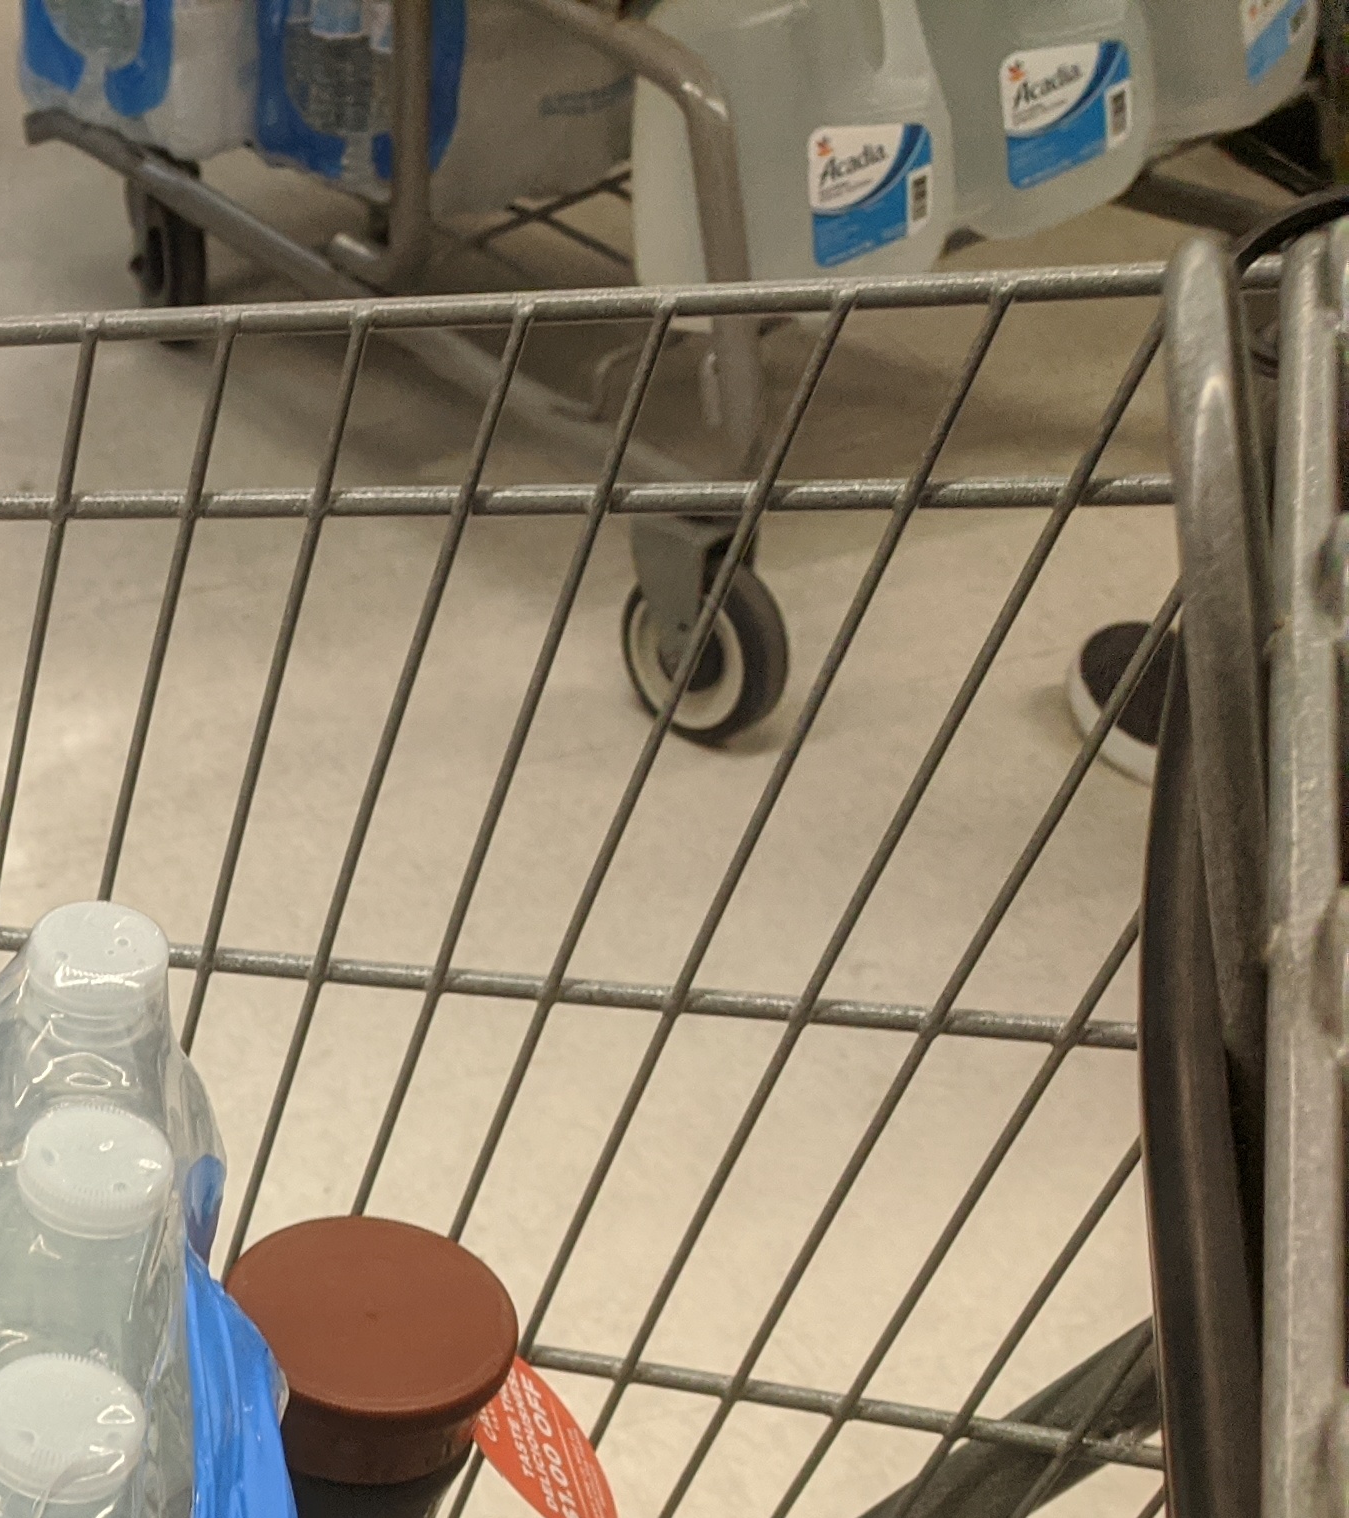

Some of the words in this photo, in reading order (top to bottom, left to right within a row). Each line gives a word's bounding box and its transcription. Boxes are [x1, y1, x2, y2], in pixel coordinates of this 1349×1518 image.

[1013, 61, 1084, 107] Acadia
[819, 143, 887, 185] Acadia
[520, 1373, 551, 1437] OFF
